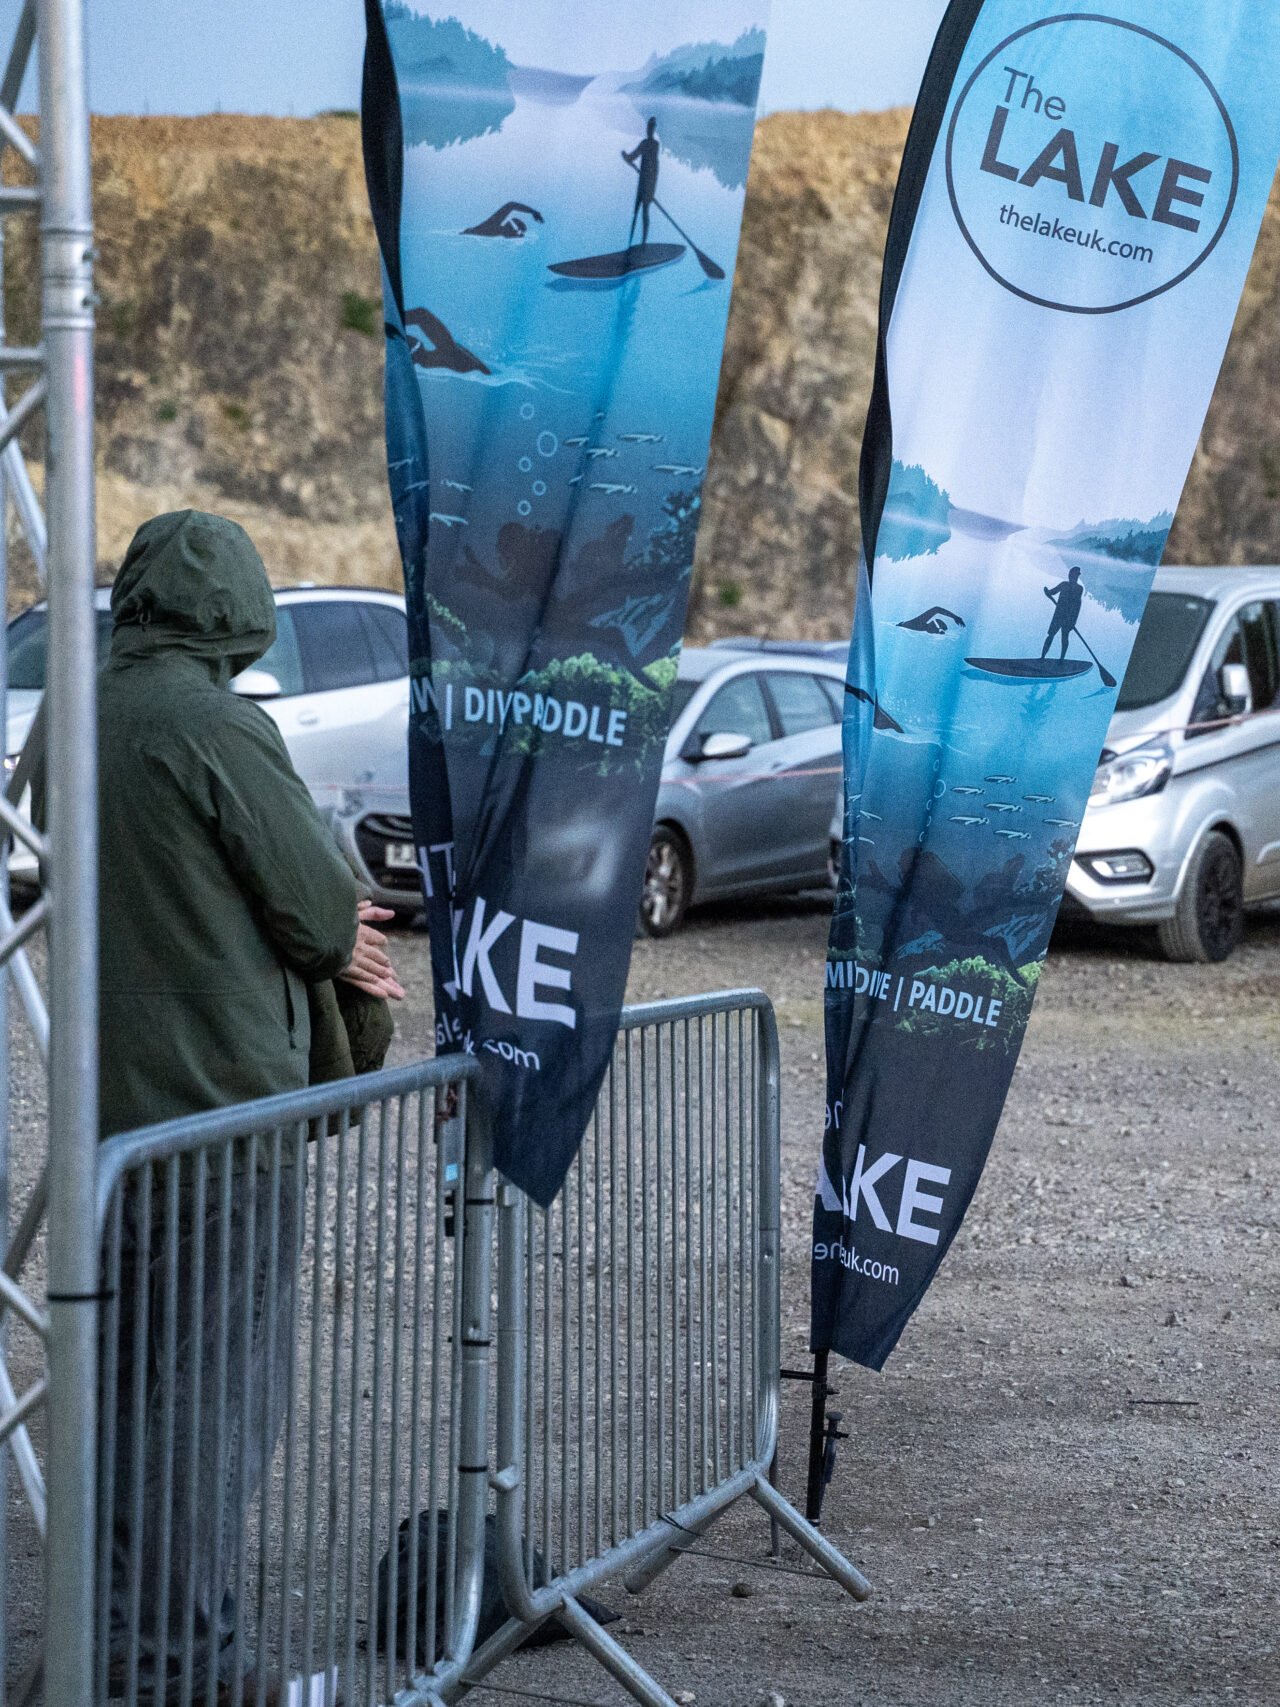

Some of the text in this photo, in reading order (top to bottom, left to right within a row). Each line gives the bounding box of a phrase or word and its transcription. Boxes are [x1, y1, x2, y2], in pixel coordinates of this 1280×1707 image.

[1003, 66, 1066, 120] The
[980, 104, 1213, 233] LAKE
[999, 203, 1154, 264] thelakeuk.com
[908, 979, 1003, 1028] PADDLE
